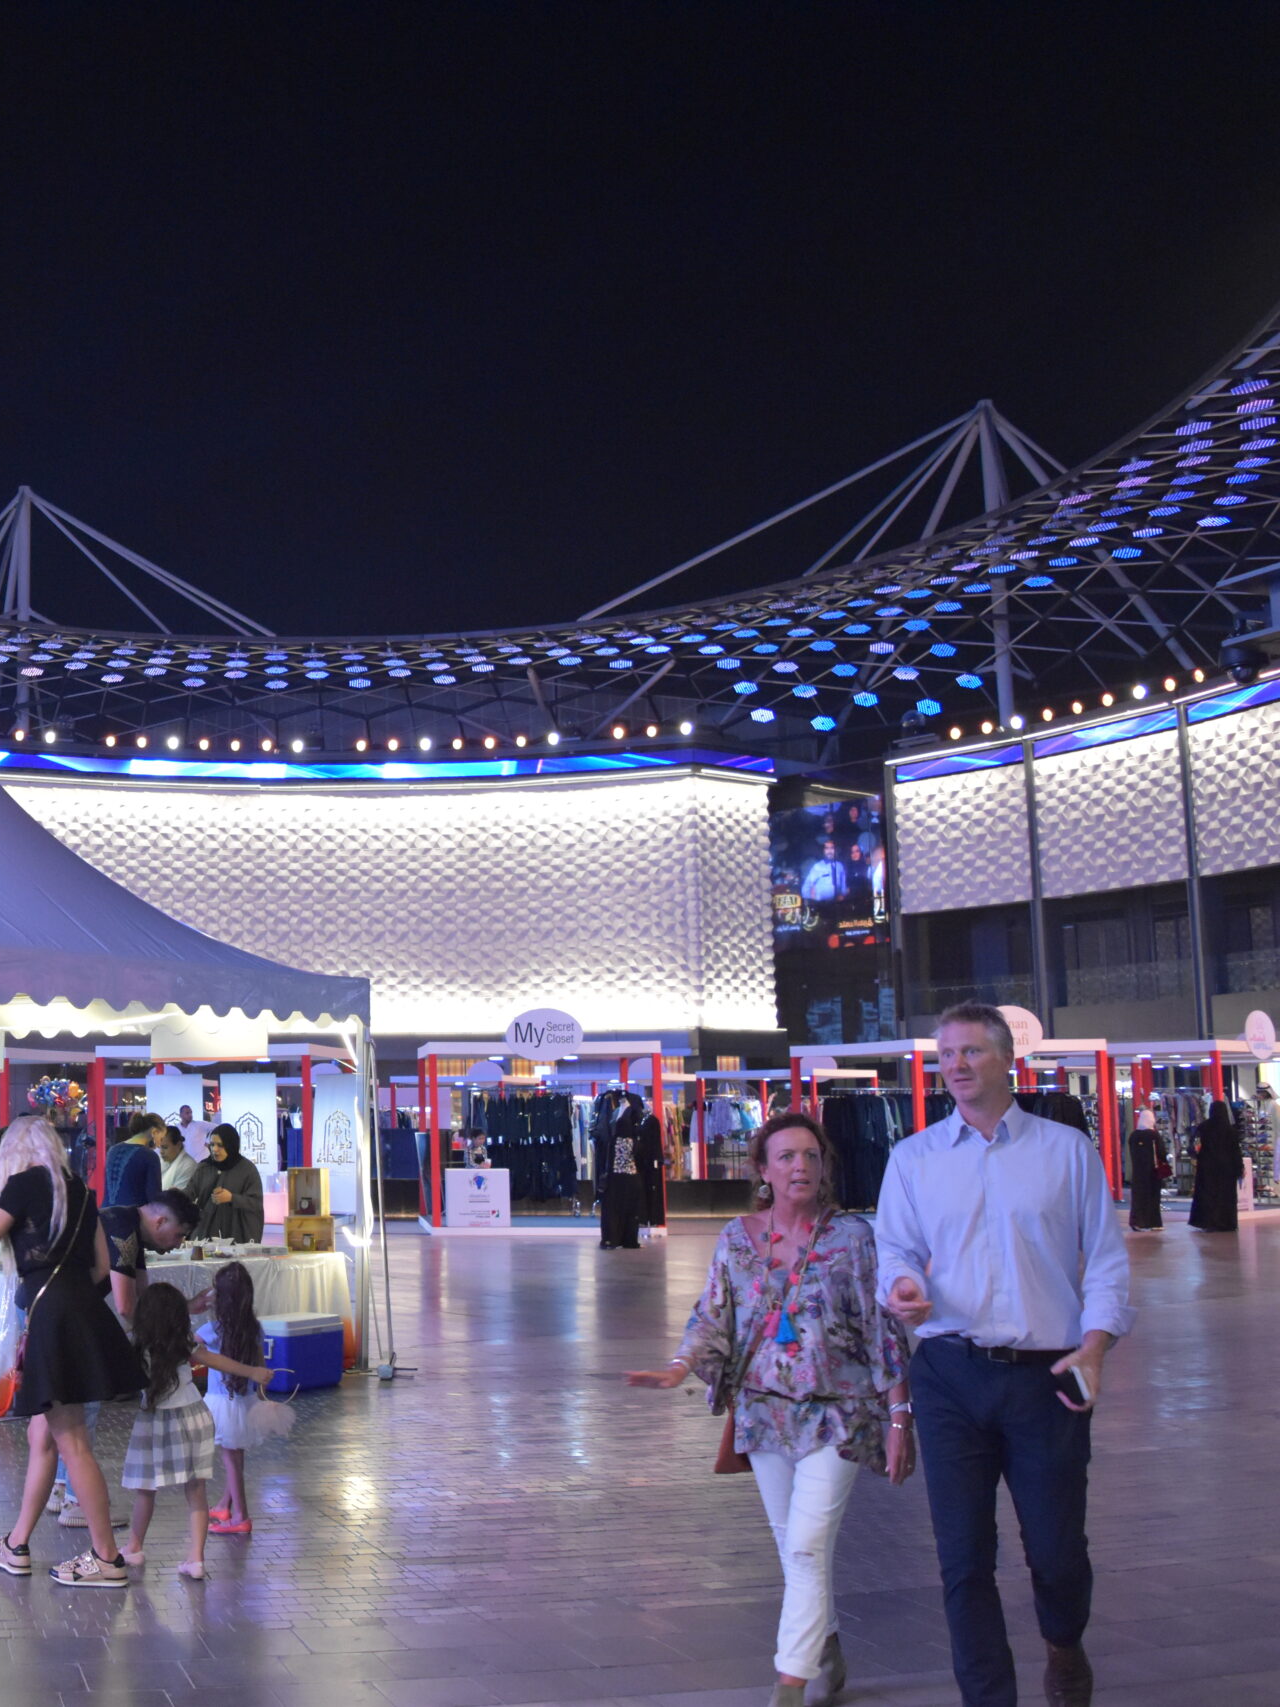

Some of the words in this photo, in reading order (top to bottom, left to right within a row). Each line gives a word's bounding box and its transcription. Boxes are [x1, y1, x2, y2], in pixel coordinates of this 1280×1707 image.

[514, 1022, 545, 1048] My
[546, 1021, 575, 1032] Secret
[546, 1033, 574, 1044] Closet
